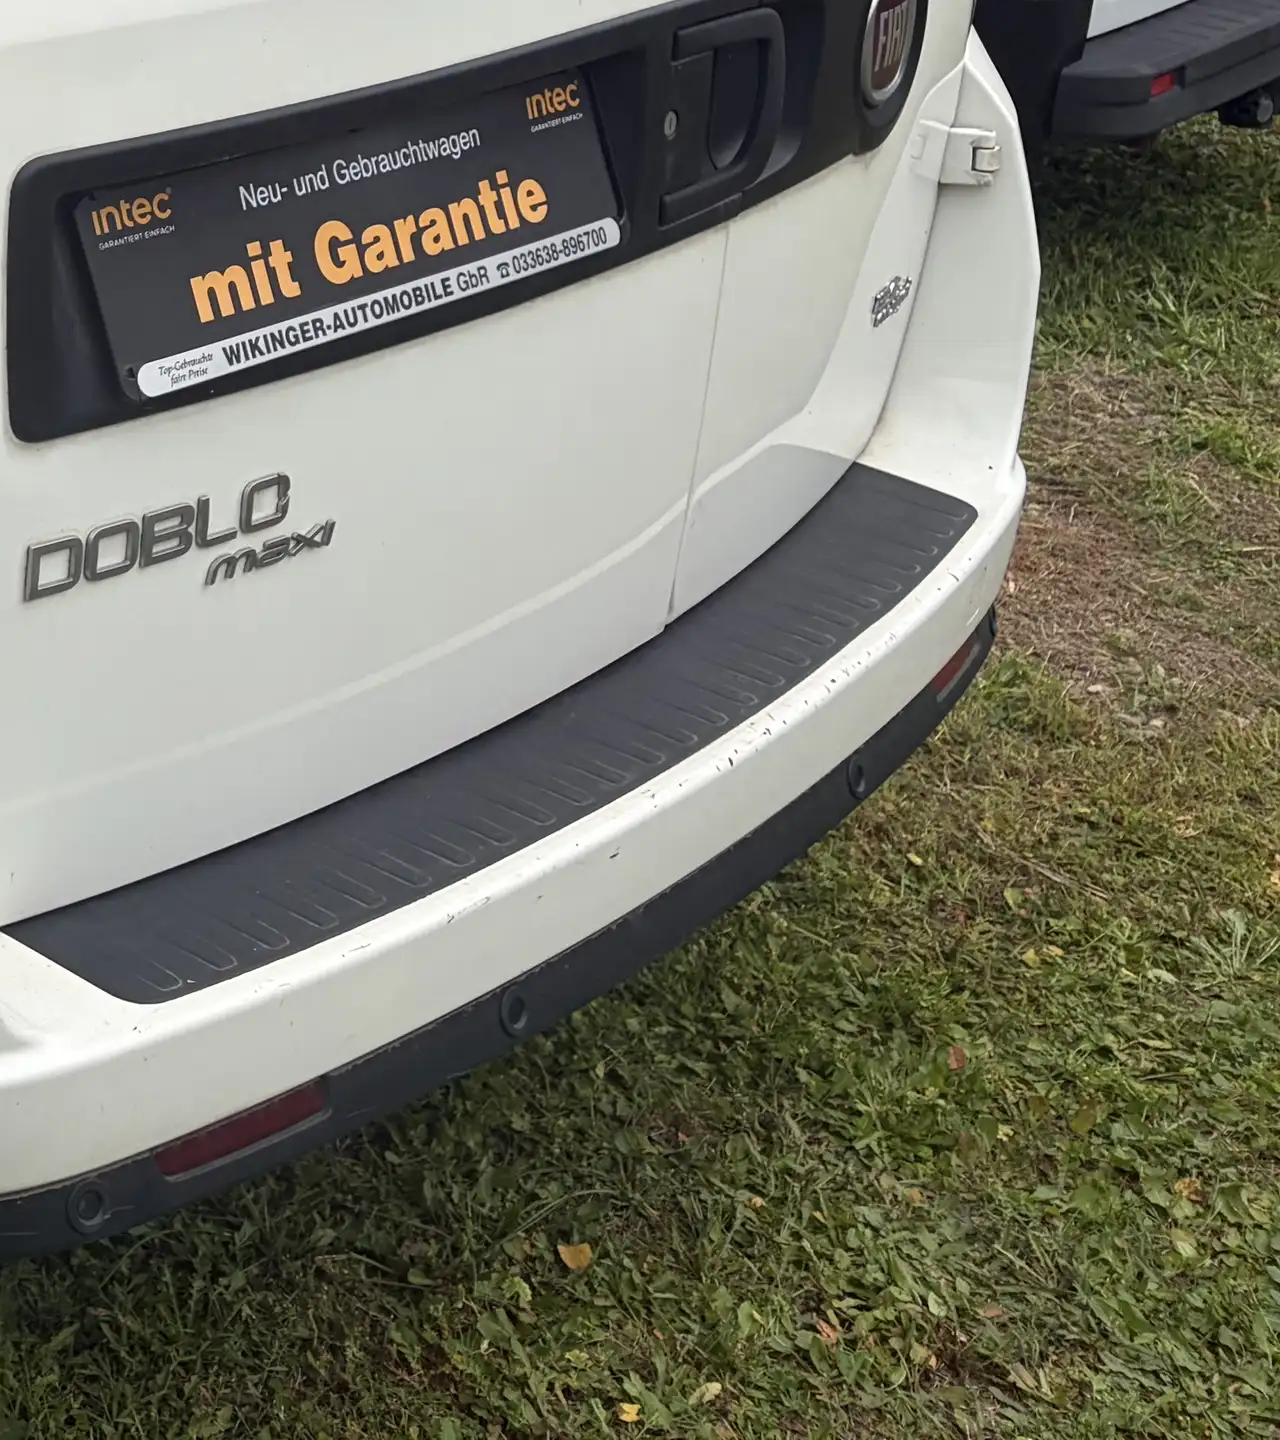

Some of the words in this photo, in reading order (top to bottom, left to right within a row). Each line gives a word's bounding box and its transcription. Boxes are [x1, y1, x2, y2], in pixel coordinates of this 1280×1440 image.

[874, 0, 909, 72] FIAT
[525, 83, 581, 120] intec
[239, 184, 289, 211] Neu-
[293, 164, 330, 197] und
[332, 128, 481, 186] Gebrauchtwagen
[91, 192, 172, 236] intec
[98, 231, 143, 251] GARANTIERT
[144, 224, 176, 240] EINFACH
[190, 239, 302, 324] mit
[314, 169, 549, 285] Garantie
[222, 276, 454, 367] WIKINGER-AUTOMOBILE
[456, 265, 491, 293] GbR
[511, 226, 608, 275] 033638-896700
